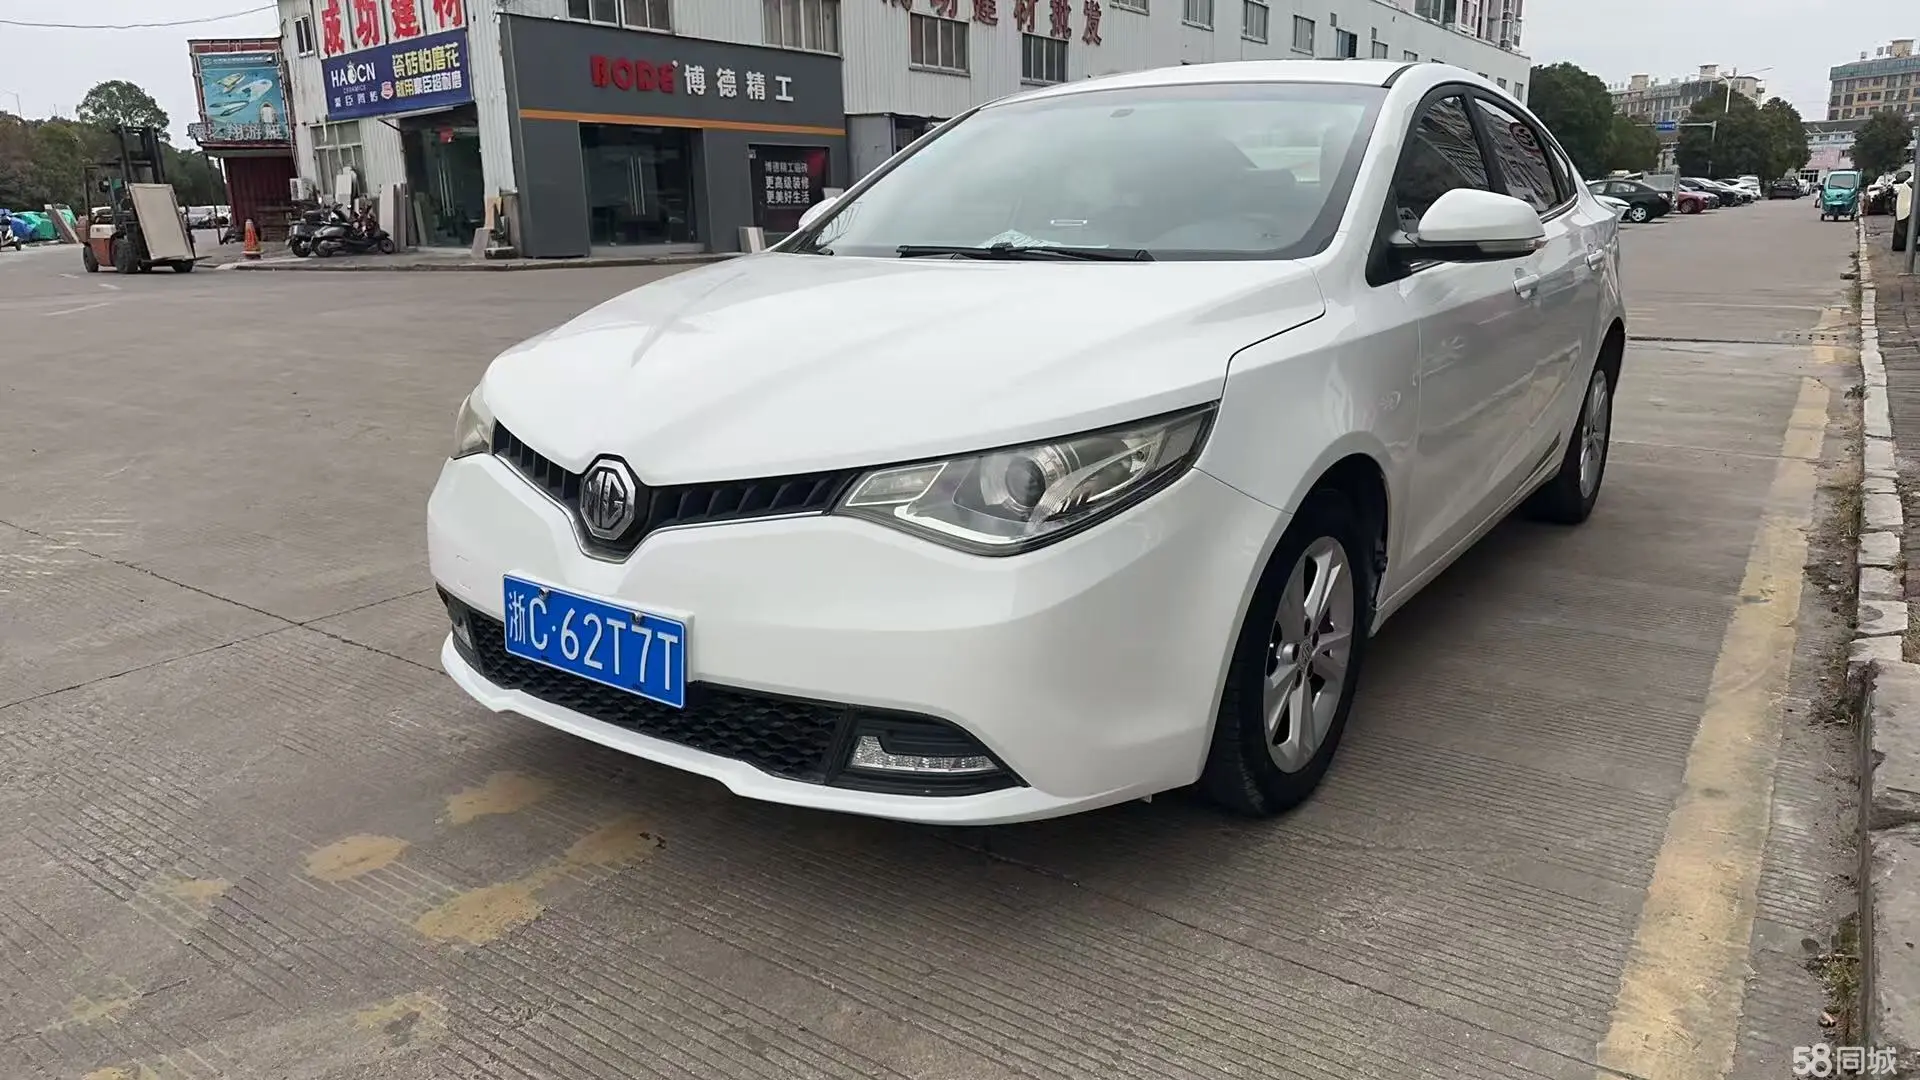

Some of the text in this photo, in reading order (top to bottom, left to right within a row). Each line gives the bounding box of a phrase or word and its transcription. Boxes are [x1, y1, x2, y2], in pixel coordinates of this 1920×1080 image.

[881, 0, 1102, 46] 建材批发
[392, 41, 461, 78] 瓷砖怕磨花
[590, 54, 794, 102] BODE 博德精工
[766, 189, 810, 204] 更美好生活
[587, 470, 625, 529] MG
